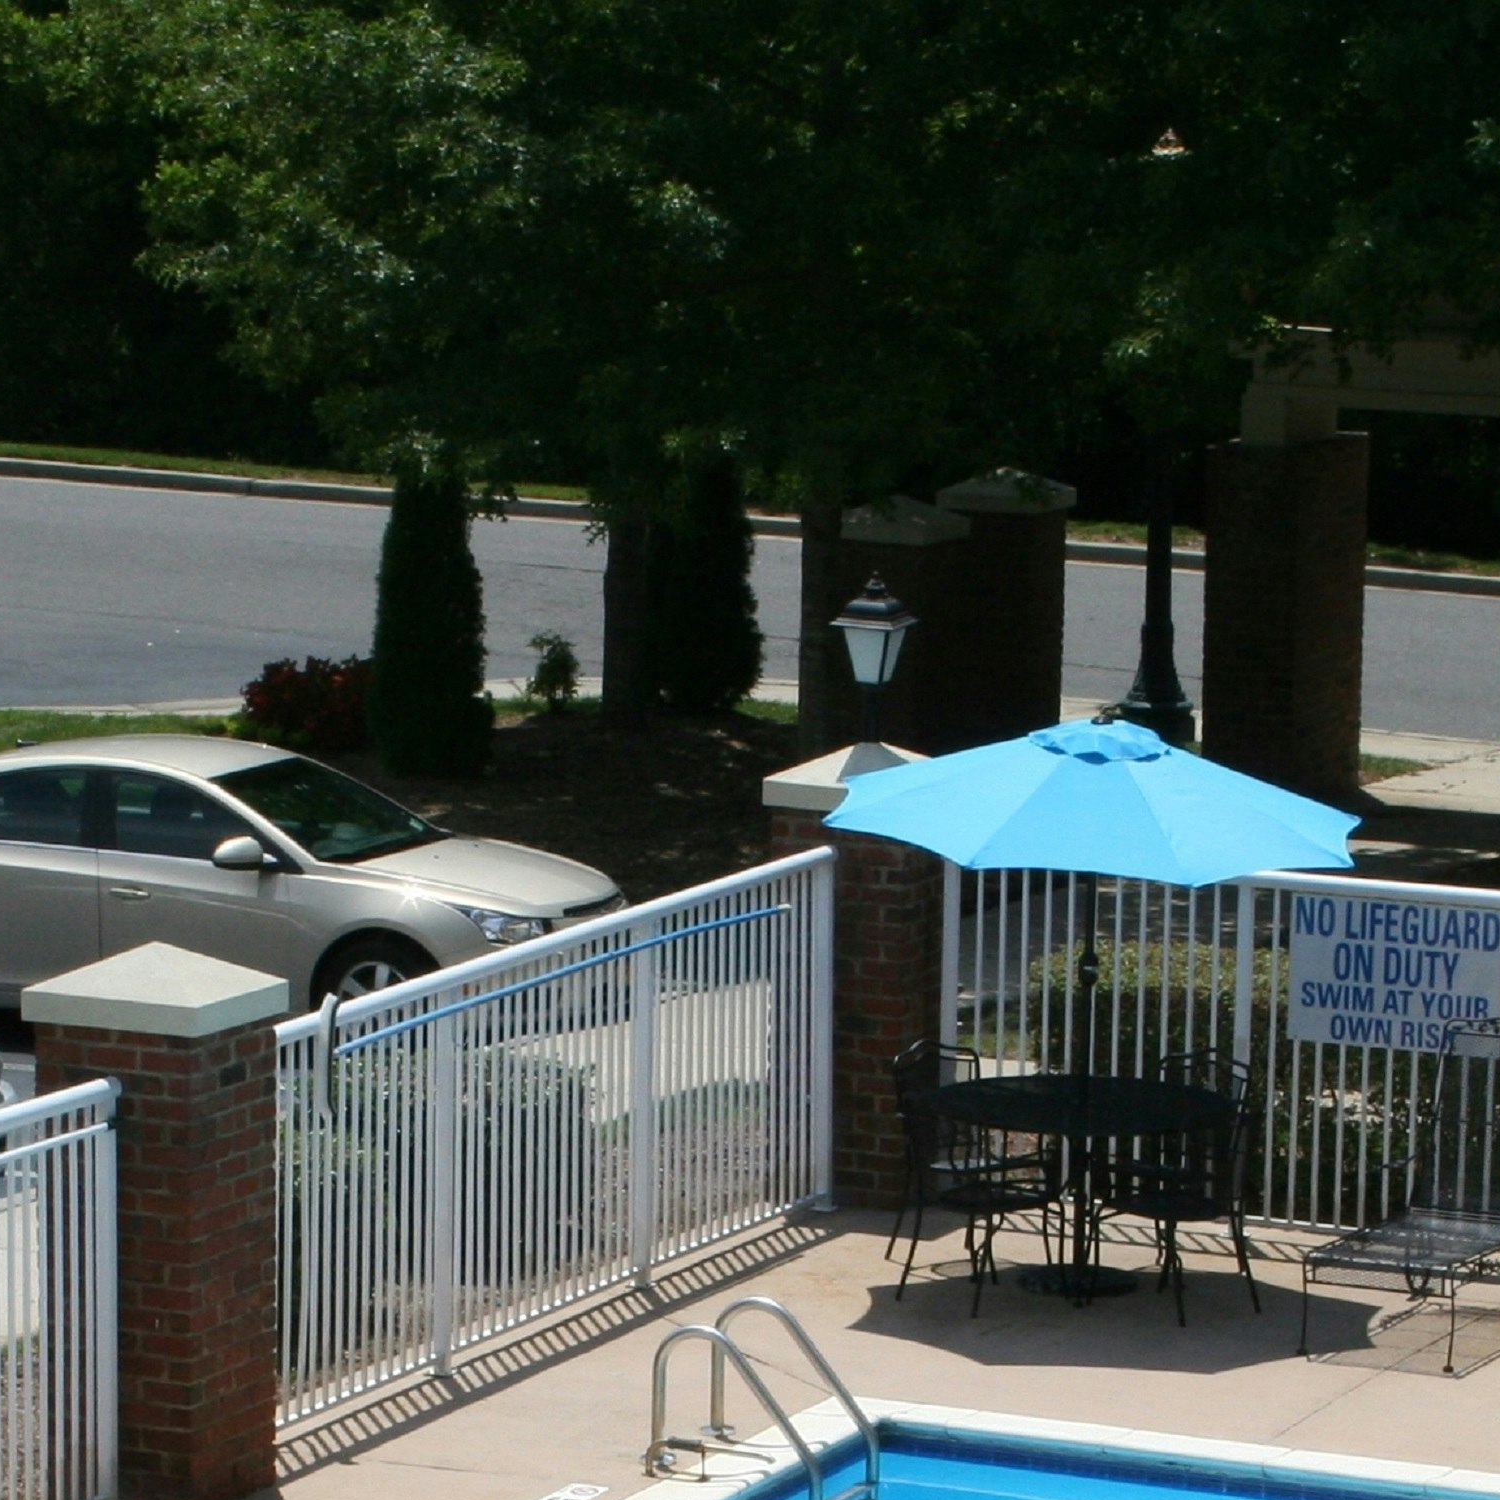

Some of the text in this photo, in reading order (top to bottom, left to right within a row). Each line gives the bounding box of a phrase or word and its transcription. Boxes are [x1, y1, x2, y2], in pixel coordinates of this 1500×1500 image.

[1295, 896, 1500, 951] NO LIFEGUARD
[1333, 943, 1460, 990] ON DUTY
[1301, 981, 1488, 1020] SWIM AT YOUR
[1330, 1014, 1392, 1046] OWN
